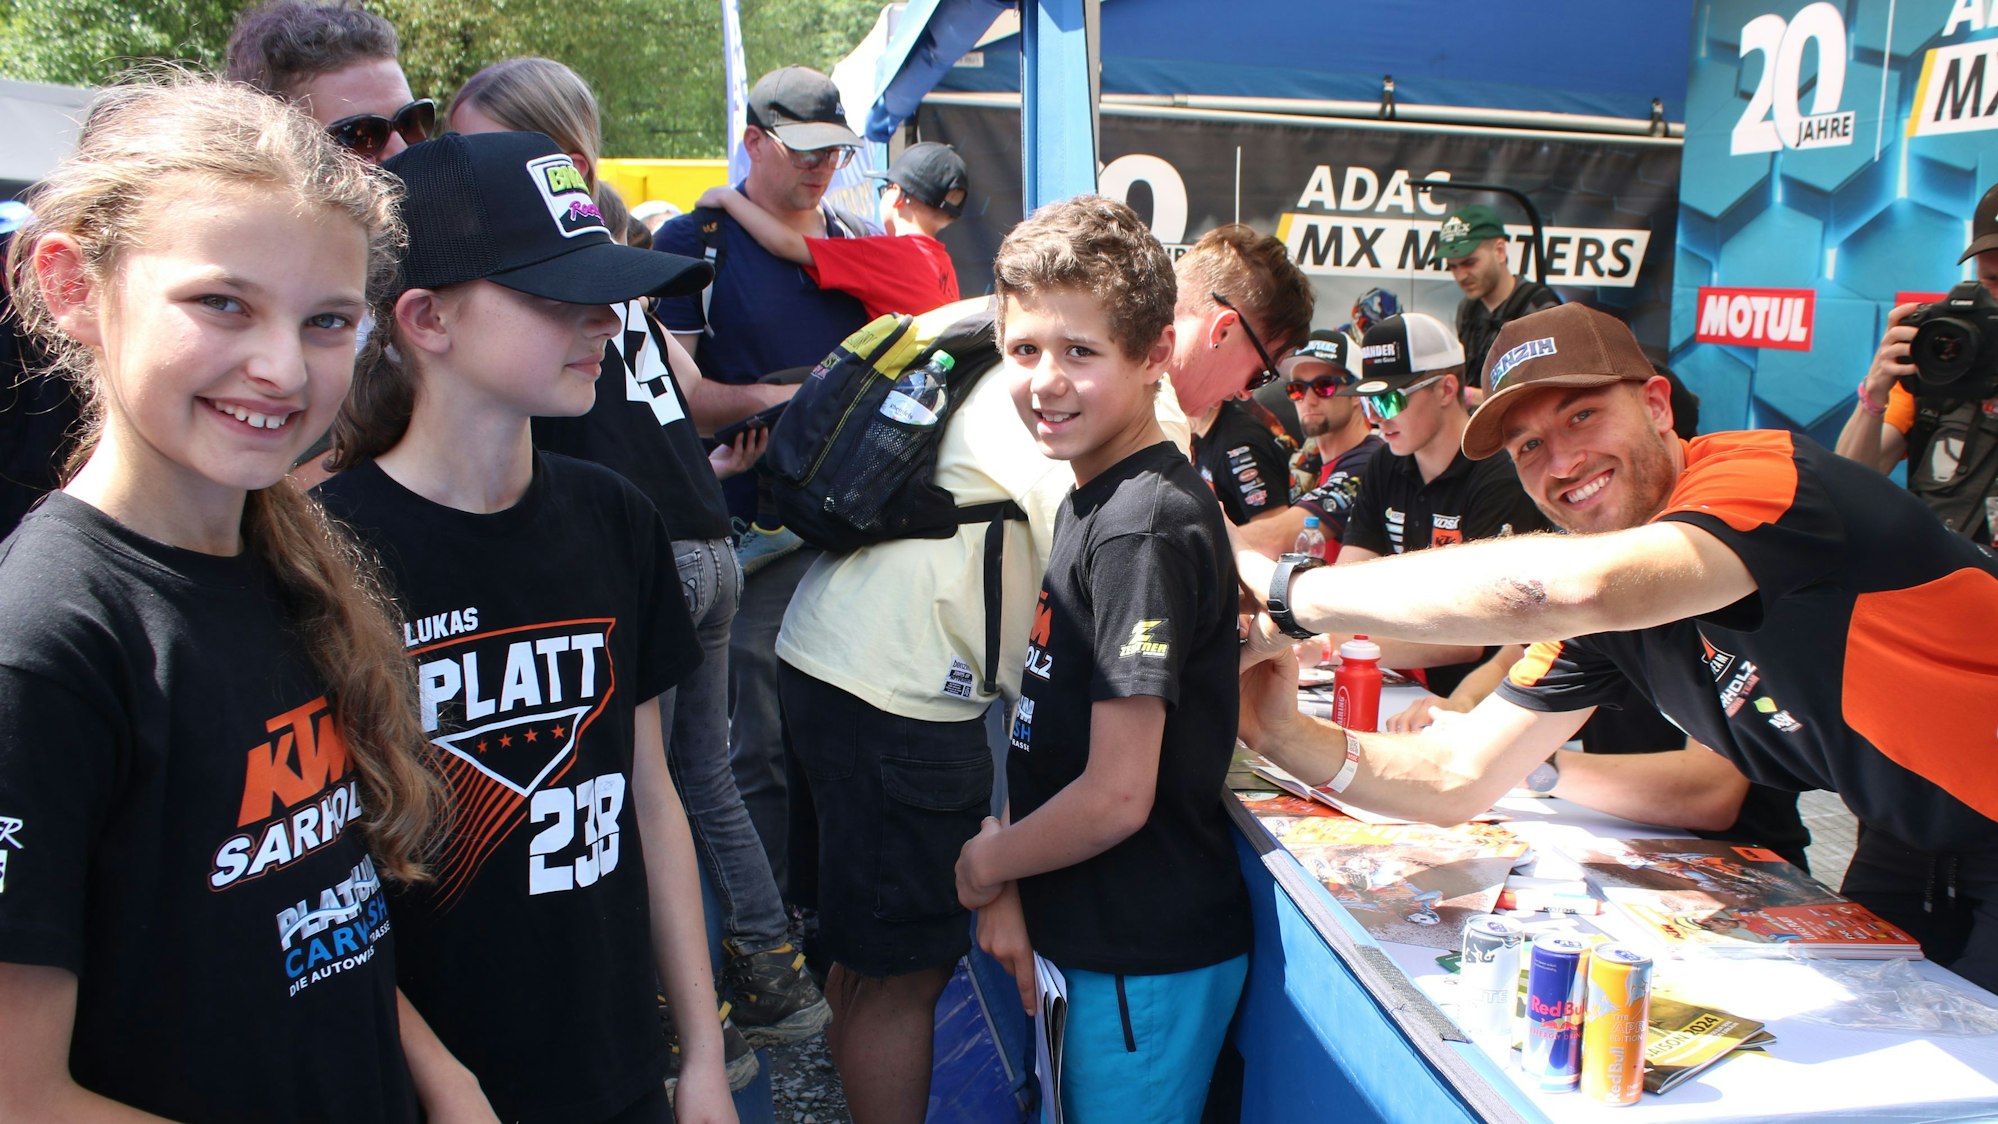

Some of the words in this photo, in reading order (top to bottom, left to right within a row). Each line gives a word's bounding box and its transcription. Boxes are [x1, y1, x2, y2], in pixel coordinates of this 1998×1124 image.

[1730, 2, 1847, 156] 20
[1796, 115, 1851, 147] JAHRE
[1297, 164, 1452, 216] ADAC
[1298, 223, 1386, 269] MX
[1397, 228, 1635, 278] MTERS
[1700, 294, 1807, 342] MOTUL
[404, 607, 479, 647] LUKAS
[418, 633, 604, 733] PLATT
[237, 696, 353, 828] KTM
[209, 780, 363, 889] SARHOL
[290, 976, 309, 997] DIE
[1531, 994, 1562, 1017] Red
